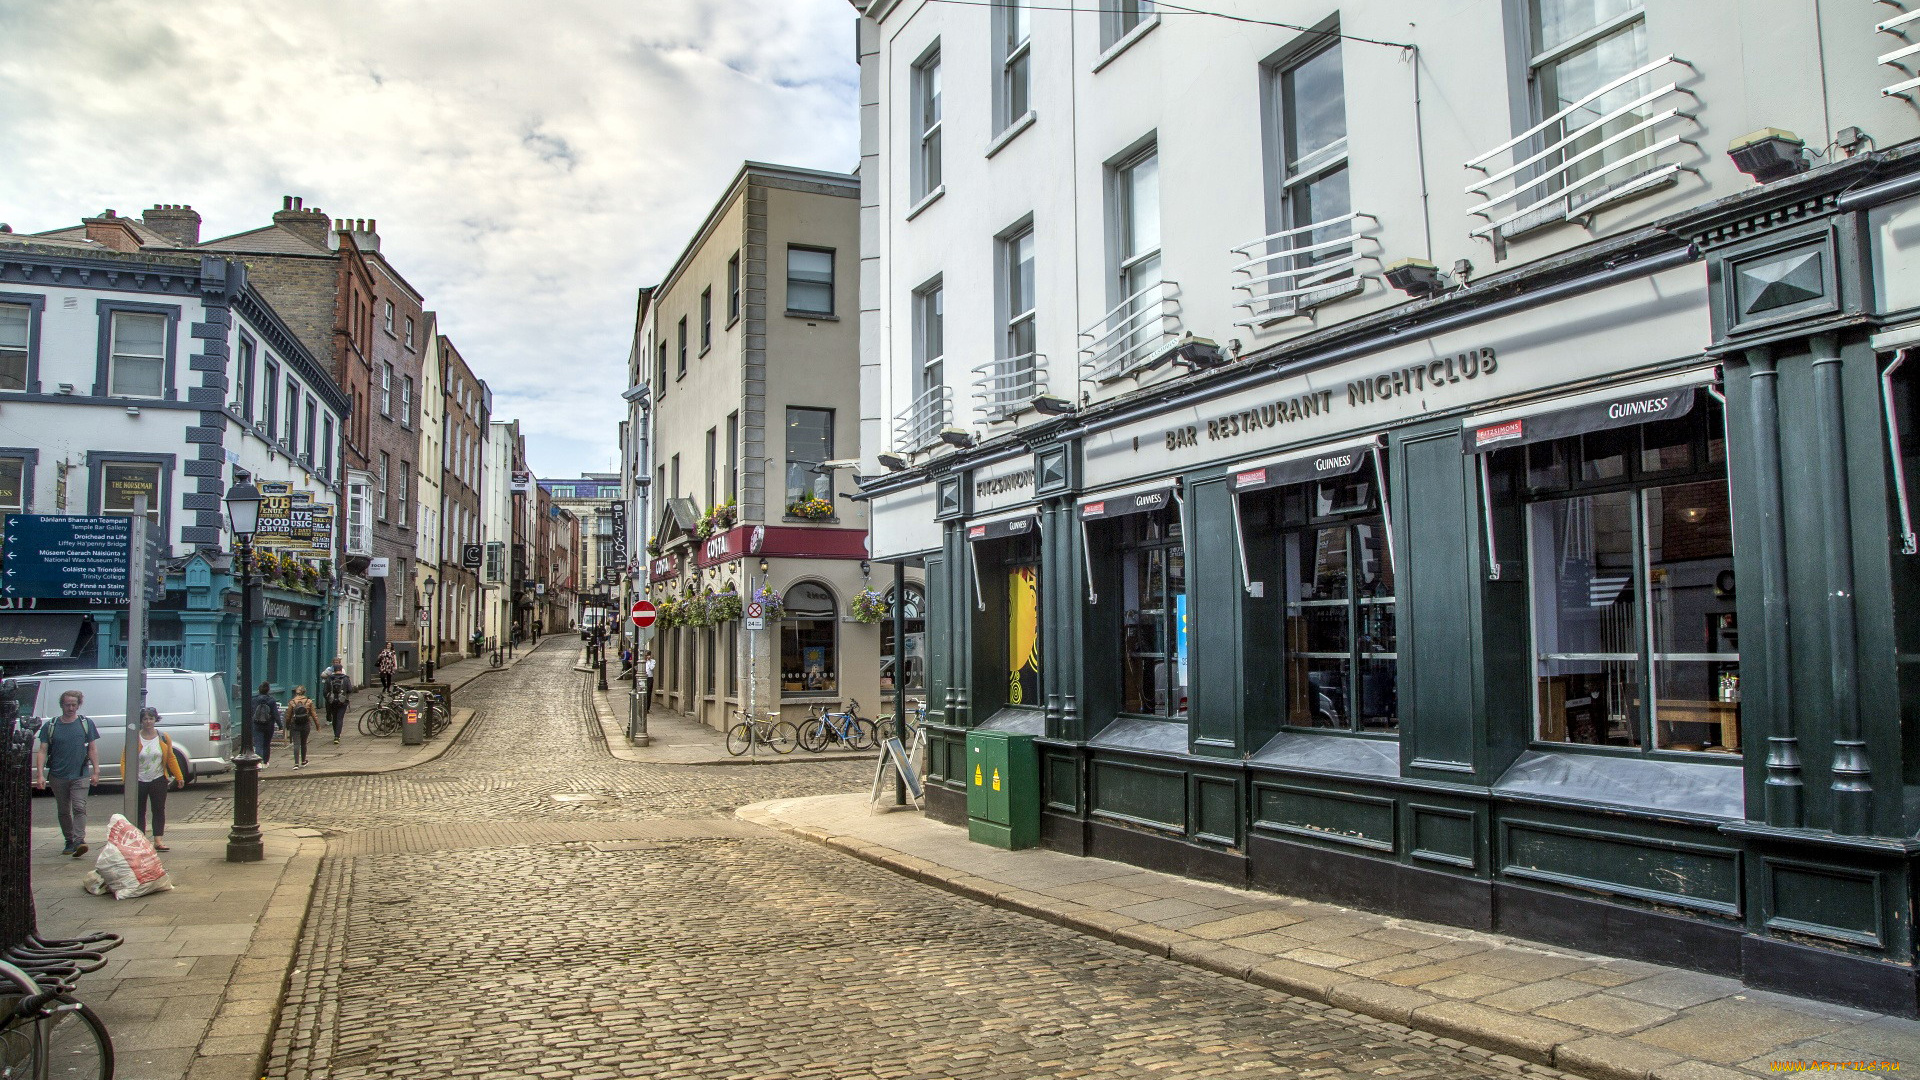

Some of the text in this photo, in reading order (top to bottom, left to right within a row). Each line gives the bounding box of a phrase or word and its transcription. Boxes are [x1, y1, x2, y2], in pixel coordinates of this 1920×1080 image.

[1166, 347, 1498, 450] BAR RESTAURANT NIGHTCLUB
[1609, 398, 1668, 418] GUINNESS
[1480, 423, 1518, 437] FITZSIMONS
[1316, 455, 1350, 470] GUINNESS
[260, 497, 290, 508] PUB
[1136, 494, 1162, 506] GUINNESS
[291, 511, 312, 520] IVE
[707, 536, 726, 558] COSTA
[656, 558, 669, 576] COSTA
[888, 590, 920, 604] CSTA
